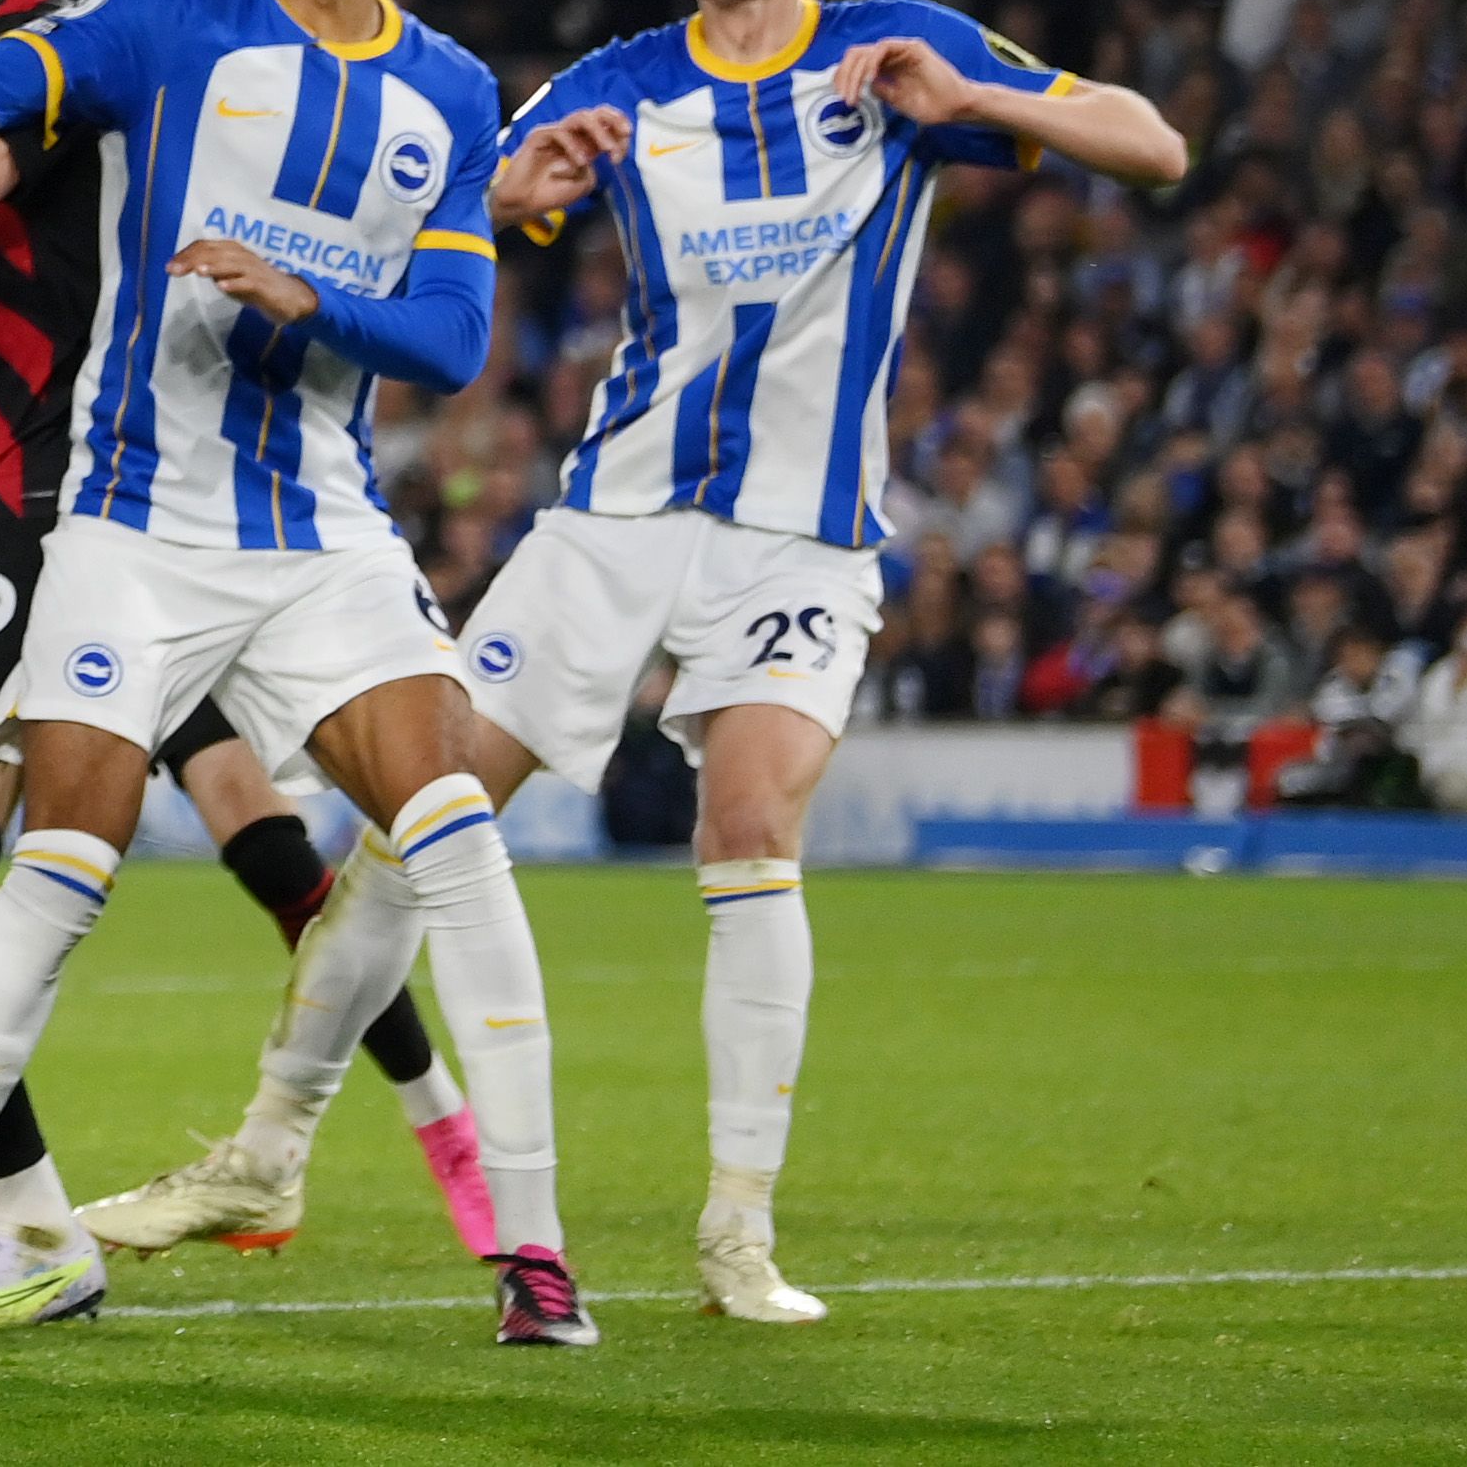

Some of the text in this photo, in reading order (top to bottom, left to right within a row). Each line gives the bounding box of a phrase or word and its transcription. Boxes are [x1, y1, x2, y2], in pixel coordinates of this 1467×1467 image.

[205, 207, 386, 283] AMERICAN
[705, 247, 820, 285] EXPRE
[744, 607, 836, 671] 29
